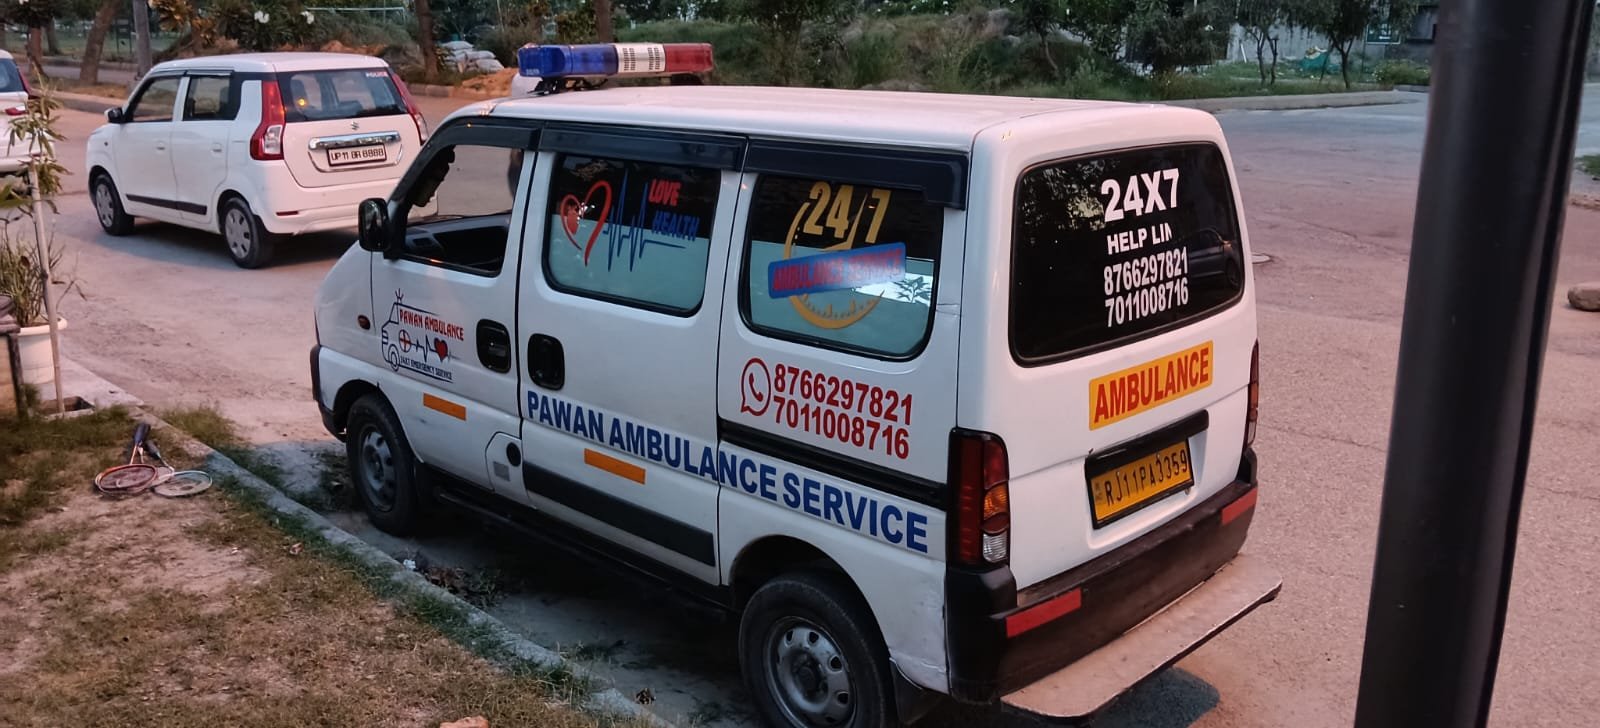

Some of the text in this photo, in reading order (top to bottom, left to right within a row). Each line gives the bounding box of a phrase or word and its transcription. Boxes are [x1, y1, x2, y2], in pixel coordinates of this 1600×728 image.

[331, 151, 341, 161] UP
[342, 151, 349, 160] 11
[648, 178, 681, 206] LOVE
[803, 181, 891, 244] 24/7
[1101, 168, 1180, 222] 24X7
[652, 210, 700, 242] HEALTH
[1107, 227, 1147, 255] HELP
[773, 257, 843, 291] AMBULANCE
[1103, 246, 1188, 296] 8766297821
[400, 309, 464, 341] PAWAN AMBULANCE
[1105, 277, 1189, 328] 7011008716
[774, 363, 913, 425] 8766297821
[1094, 347, 1209, 423] AMBULANCE
[773, 395, 909, 460] 7011008716
[527, 390, 928, 554] PAWAN AMBULANCE SERVICE
[1104, 449, 1187, 506] RJ11PA3359
